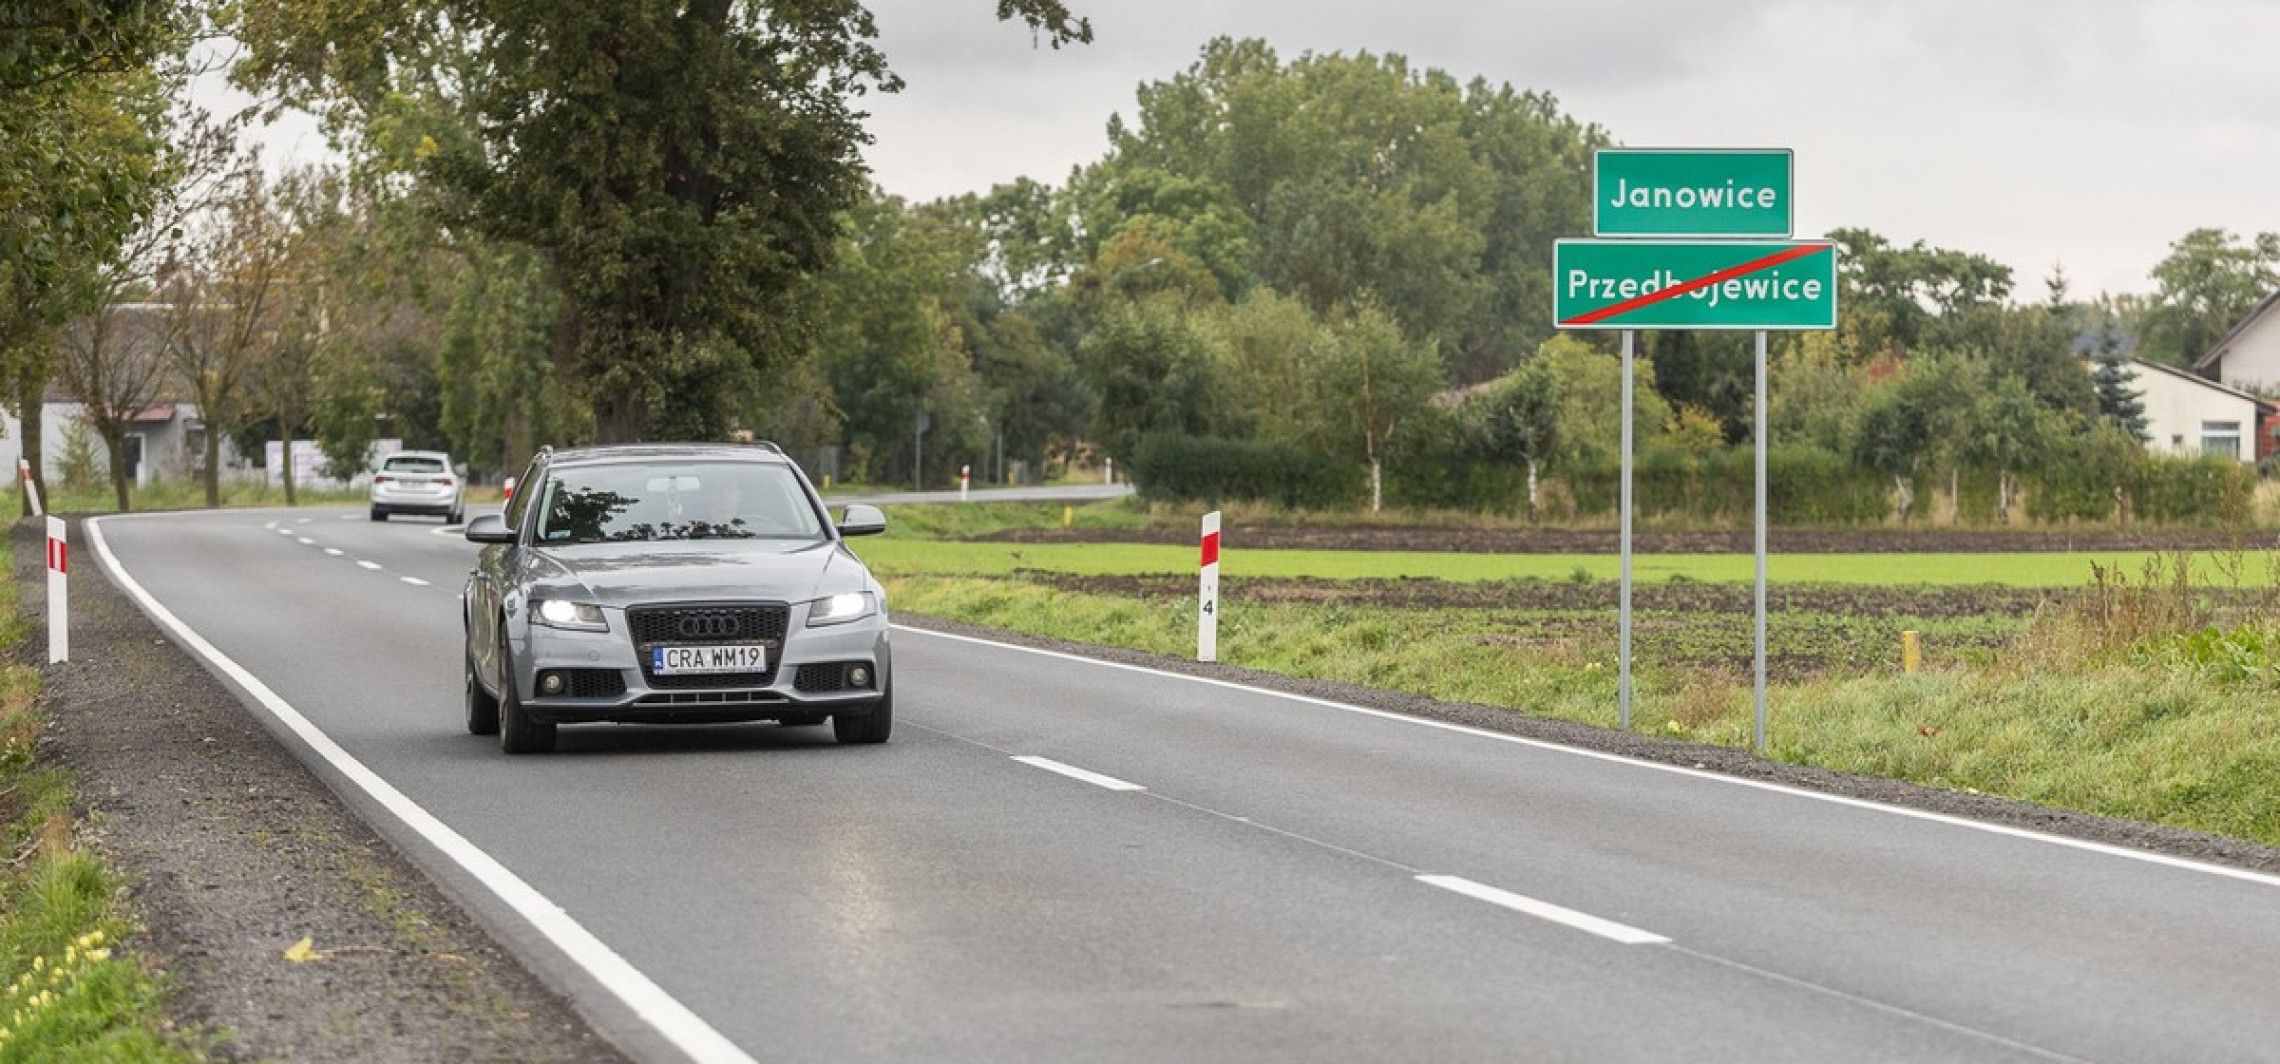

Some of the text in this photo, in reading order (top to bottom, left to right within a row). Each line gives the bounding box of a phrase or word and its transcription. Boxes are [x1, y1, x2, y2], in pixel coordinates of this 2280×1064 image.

[1610, 178, 1777, 208] Janowice
[1203, 600, 1213, 615] 4
[667, 647, 760, 668] CRA WM19
